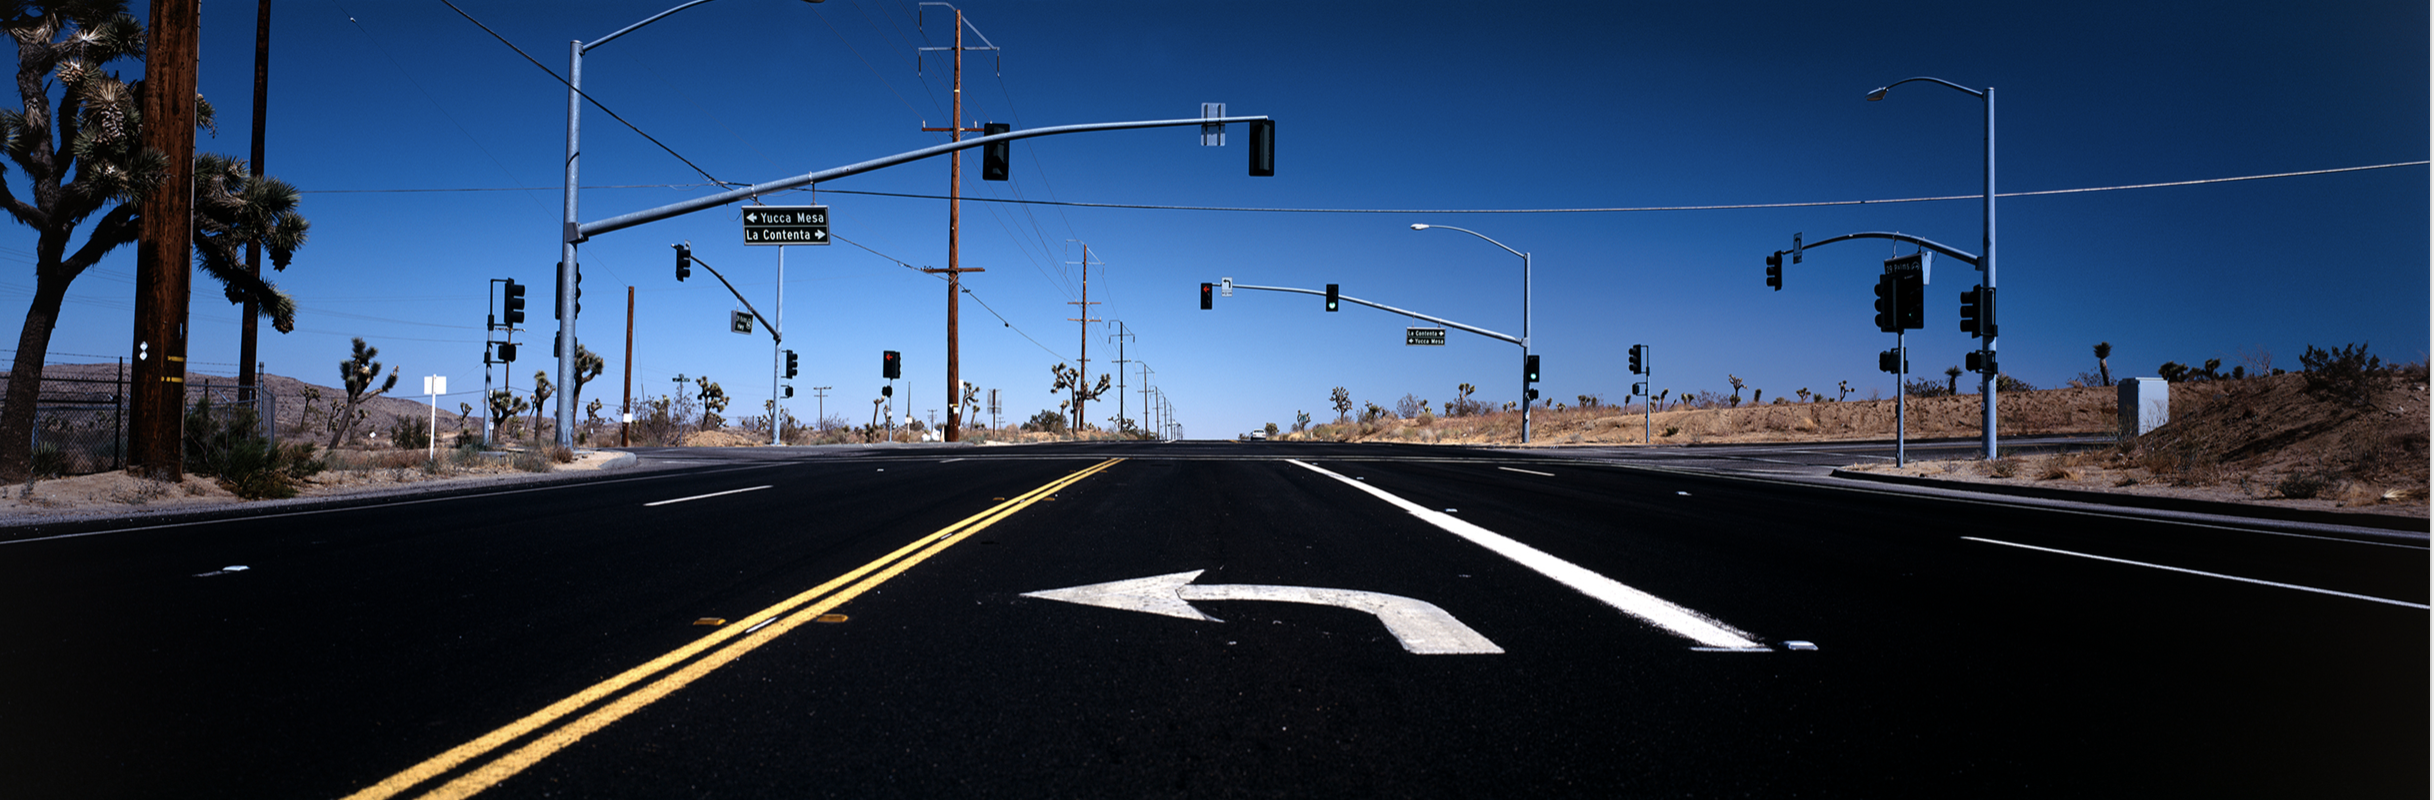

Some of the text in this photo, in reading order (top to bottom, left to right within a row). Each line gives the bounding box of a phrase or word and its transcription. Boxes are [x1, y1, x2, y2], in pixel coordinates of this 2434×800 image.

[760, 212, 824, 224] Yucca Mesa
[746, 229, 811, 240] La Contenta
